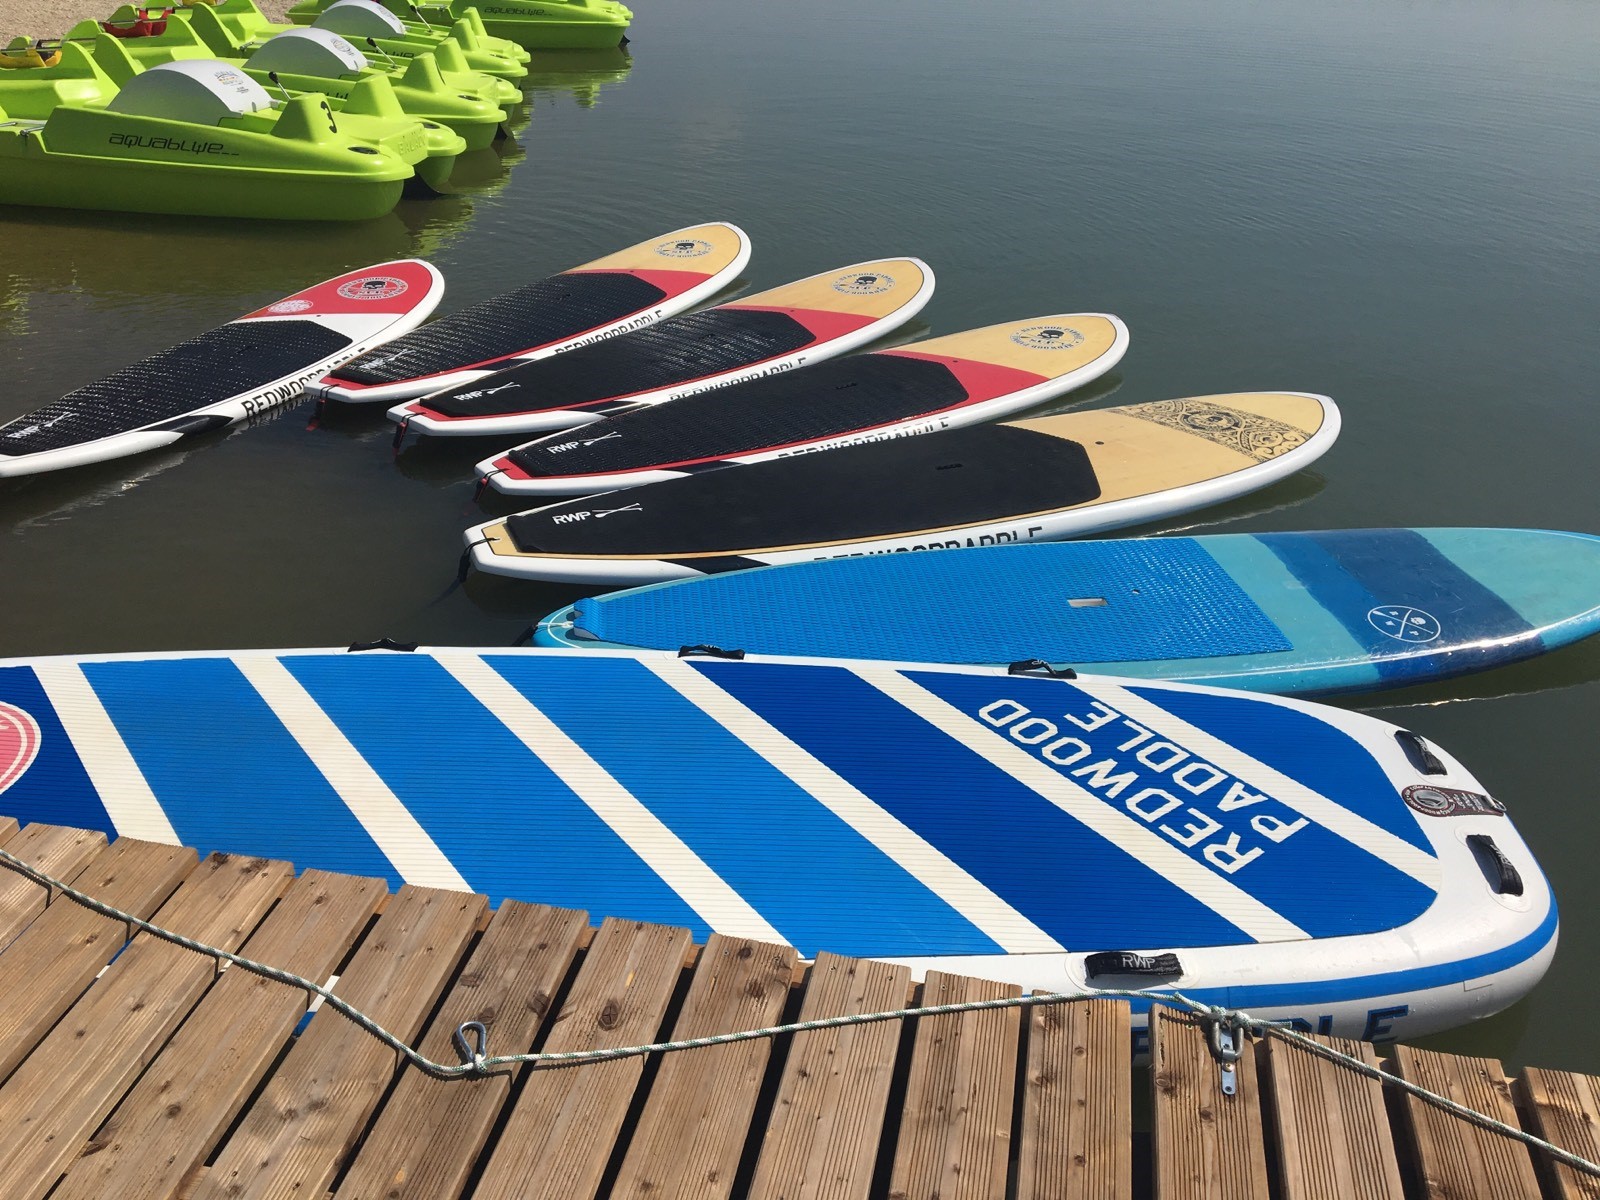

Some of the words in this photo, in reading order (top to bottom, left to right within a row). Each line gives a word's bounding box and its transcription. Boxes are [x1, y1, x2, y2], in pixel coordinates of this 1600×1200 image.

[546, 441, 579, 454] RWP
[552, 511, 591, 525] RWP
[1063, 702, 1310, 843] PADDLE
[978, 699, 1266, 874] REDWOOD
[1121, 953, 1156, 969] RWP
